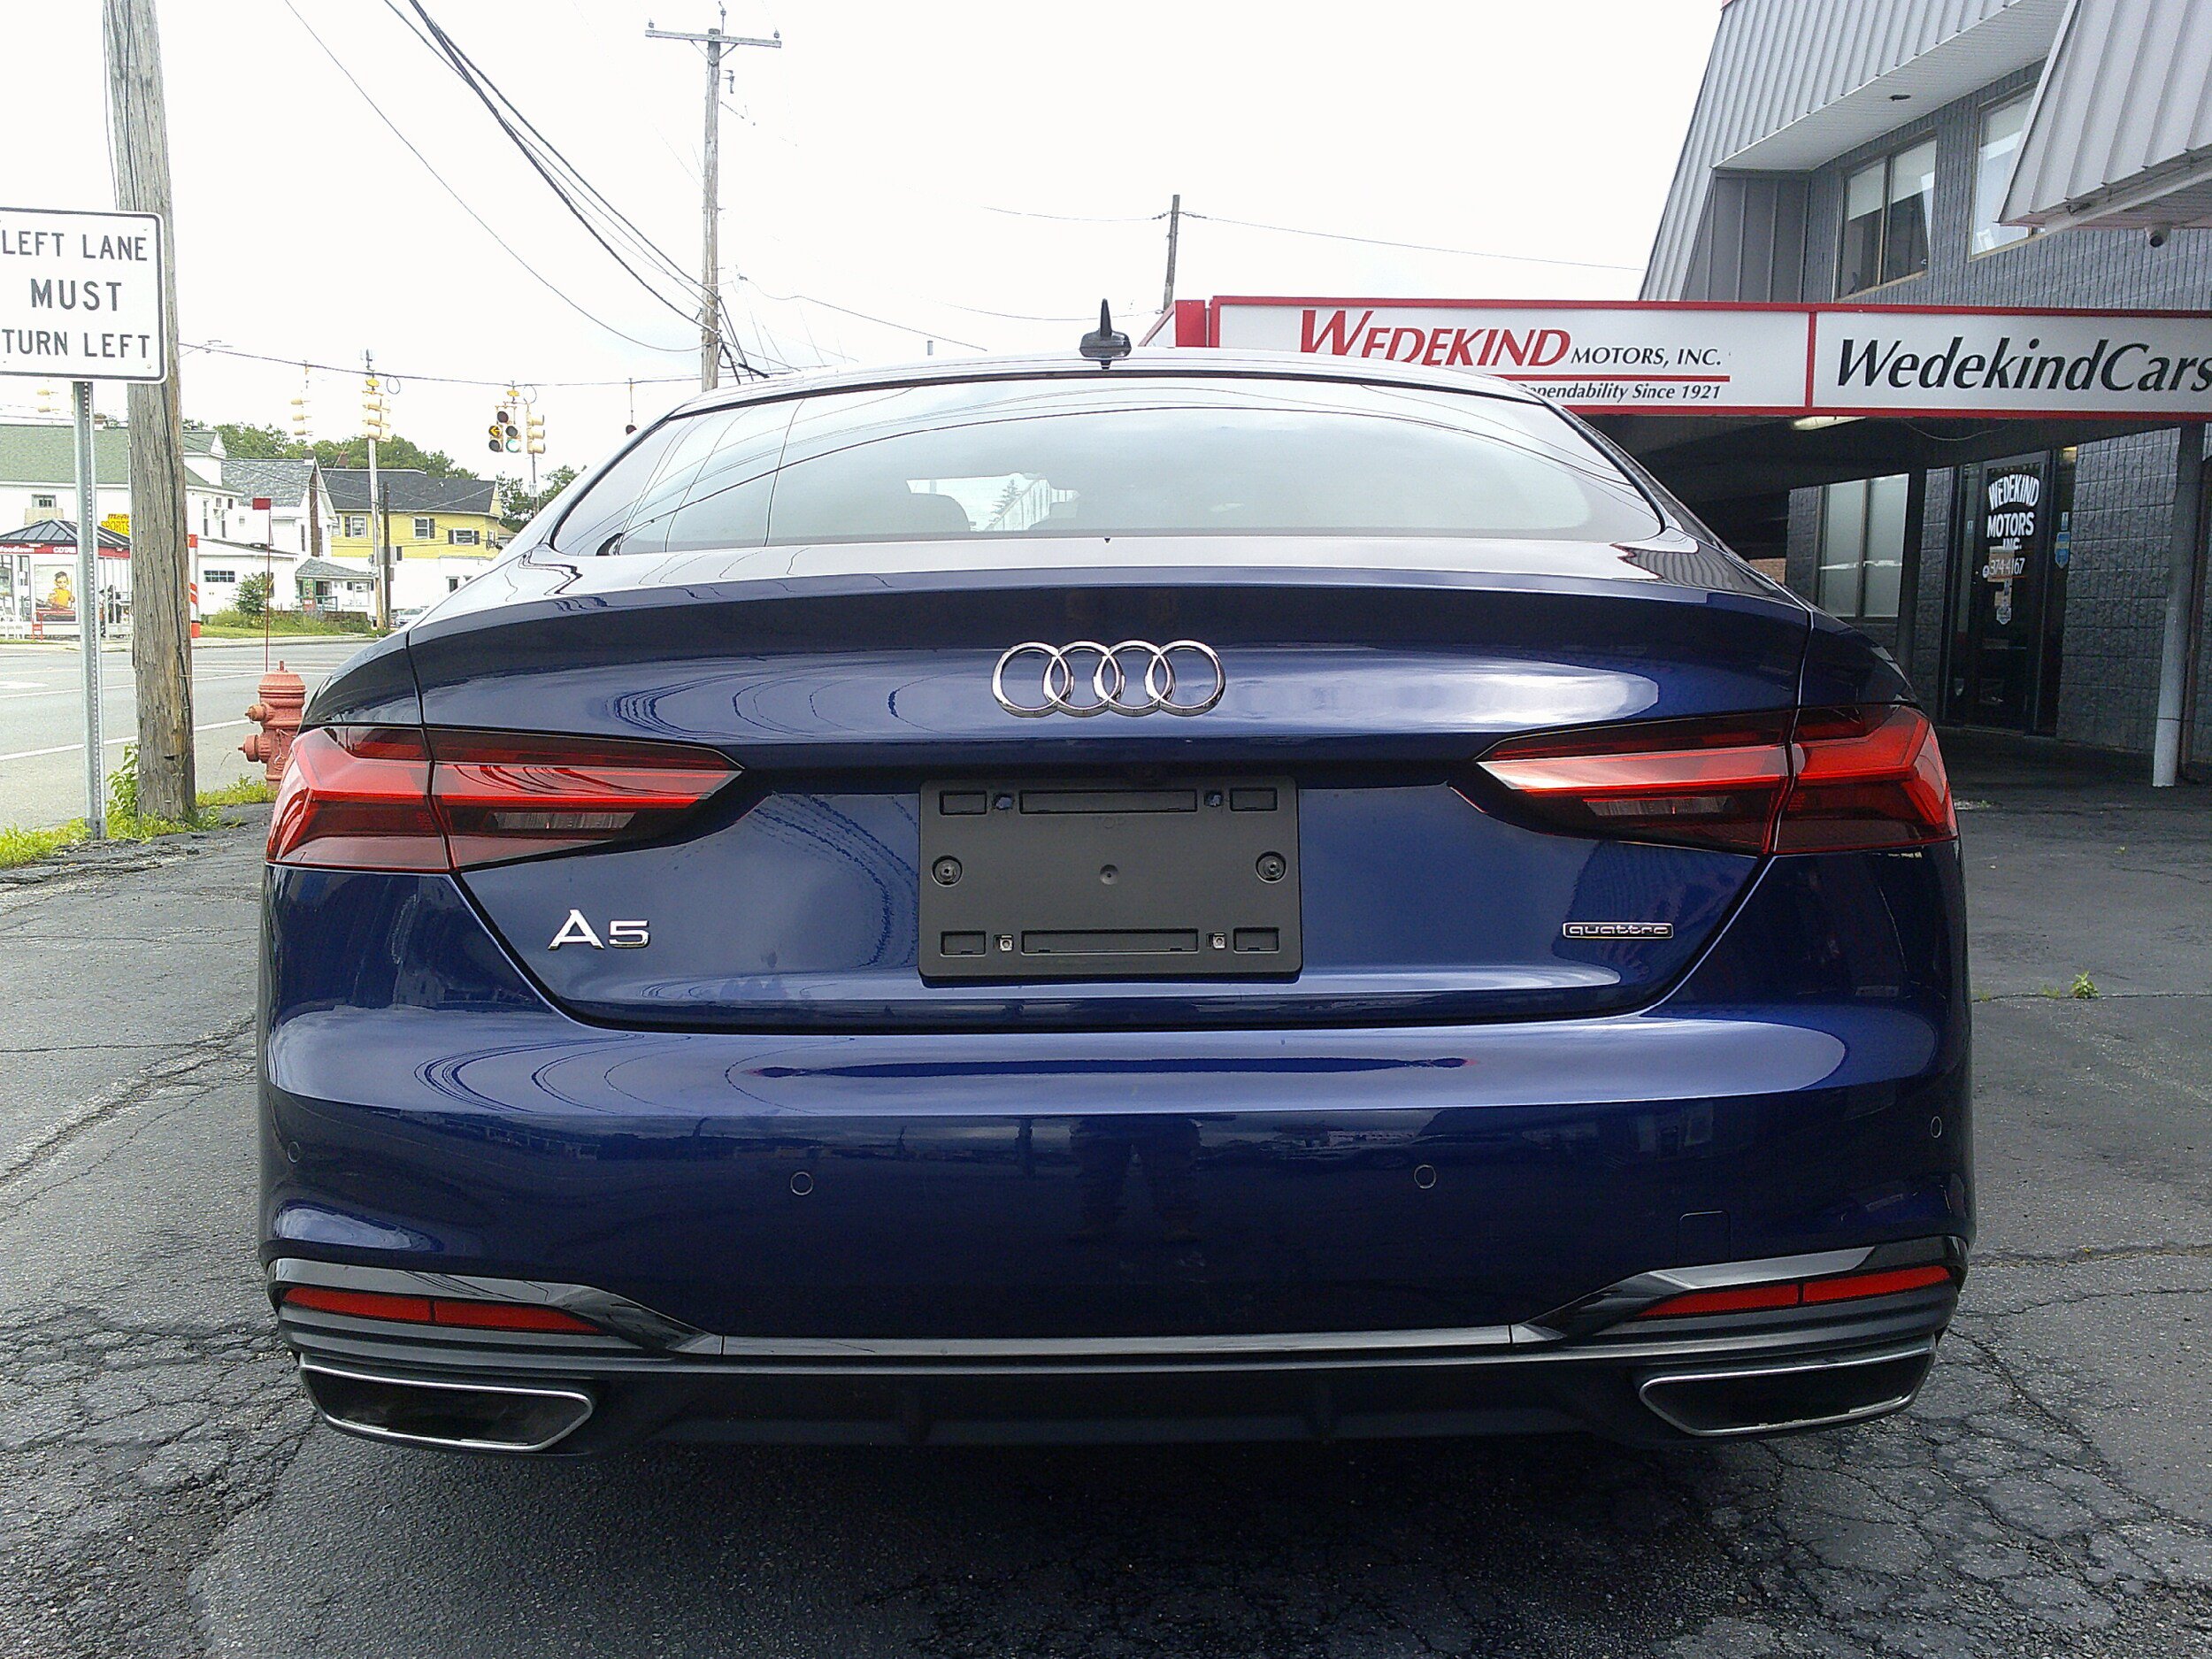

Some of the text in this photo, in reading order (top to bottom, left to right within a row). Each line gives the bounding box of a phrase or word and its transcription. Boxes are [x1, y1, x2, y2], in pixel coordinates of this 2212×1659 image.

[2, 229, 148, 261] LEFT LANE
[30, 278, 122, 311] MUST
[2, 328, 150, 358] TURN LEFT
[1301, 310, 1722, 369] WEDEKIND MOTORS, INC.
[1837, 336, 2212, 392] WedekindCars
[1519, 382, 1721, 403] pendability Since 1921
[1988, 473, 2040, 511] WEDEKIND
[1986, 511, 2035, 539] MOTORS
[2002, 537, 2023, 550] INC.
[548, 909, 650, 950] A5
[1569, 925, 1669, 936] quattro
